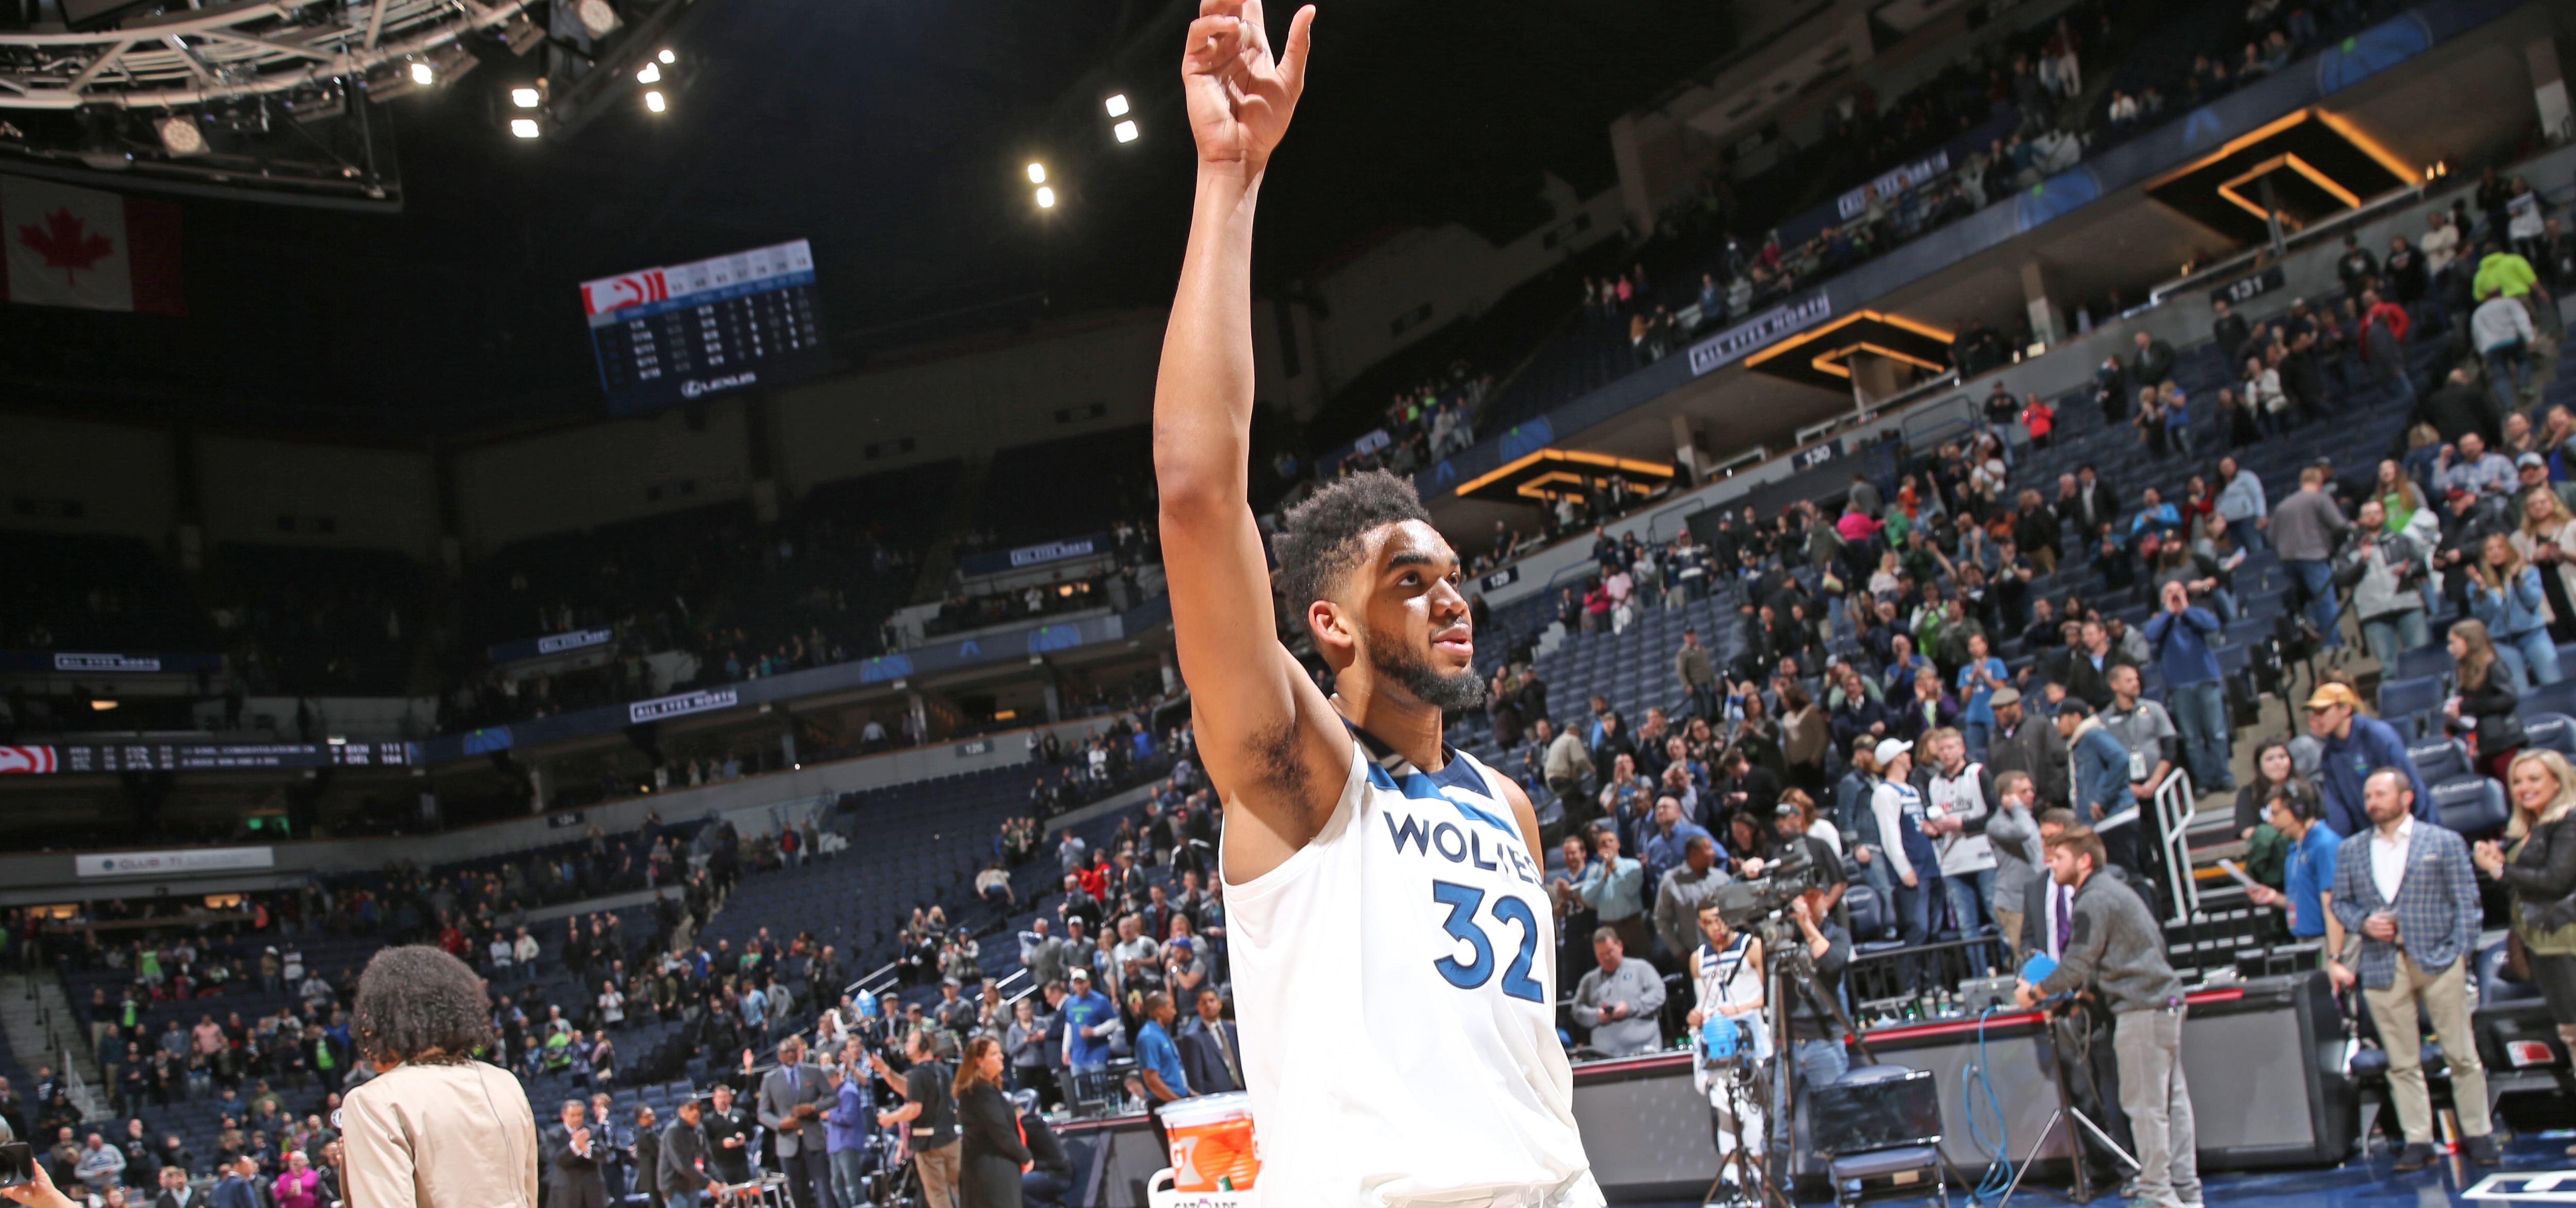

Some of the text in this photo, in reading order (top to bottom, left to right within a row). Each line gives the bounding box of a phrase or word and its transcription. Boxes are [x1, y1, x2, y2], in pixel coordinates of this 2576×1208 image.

[2229, 276, 2263, 301] 131
[1805, 444, 1831, 466] 130
[1490, 571, 1510, 587] 129
[1433, 879, 1544, 1004] 32
[1171, 1142, 1183, 1169] G
